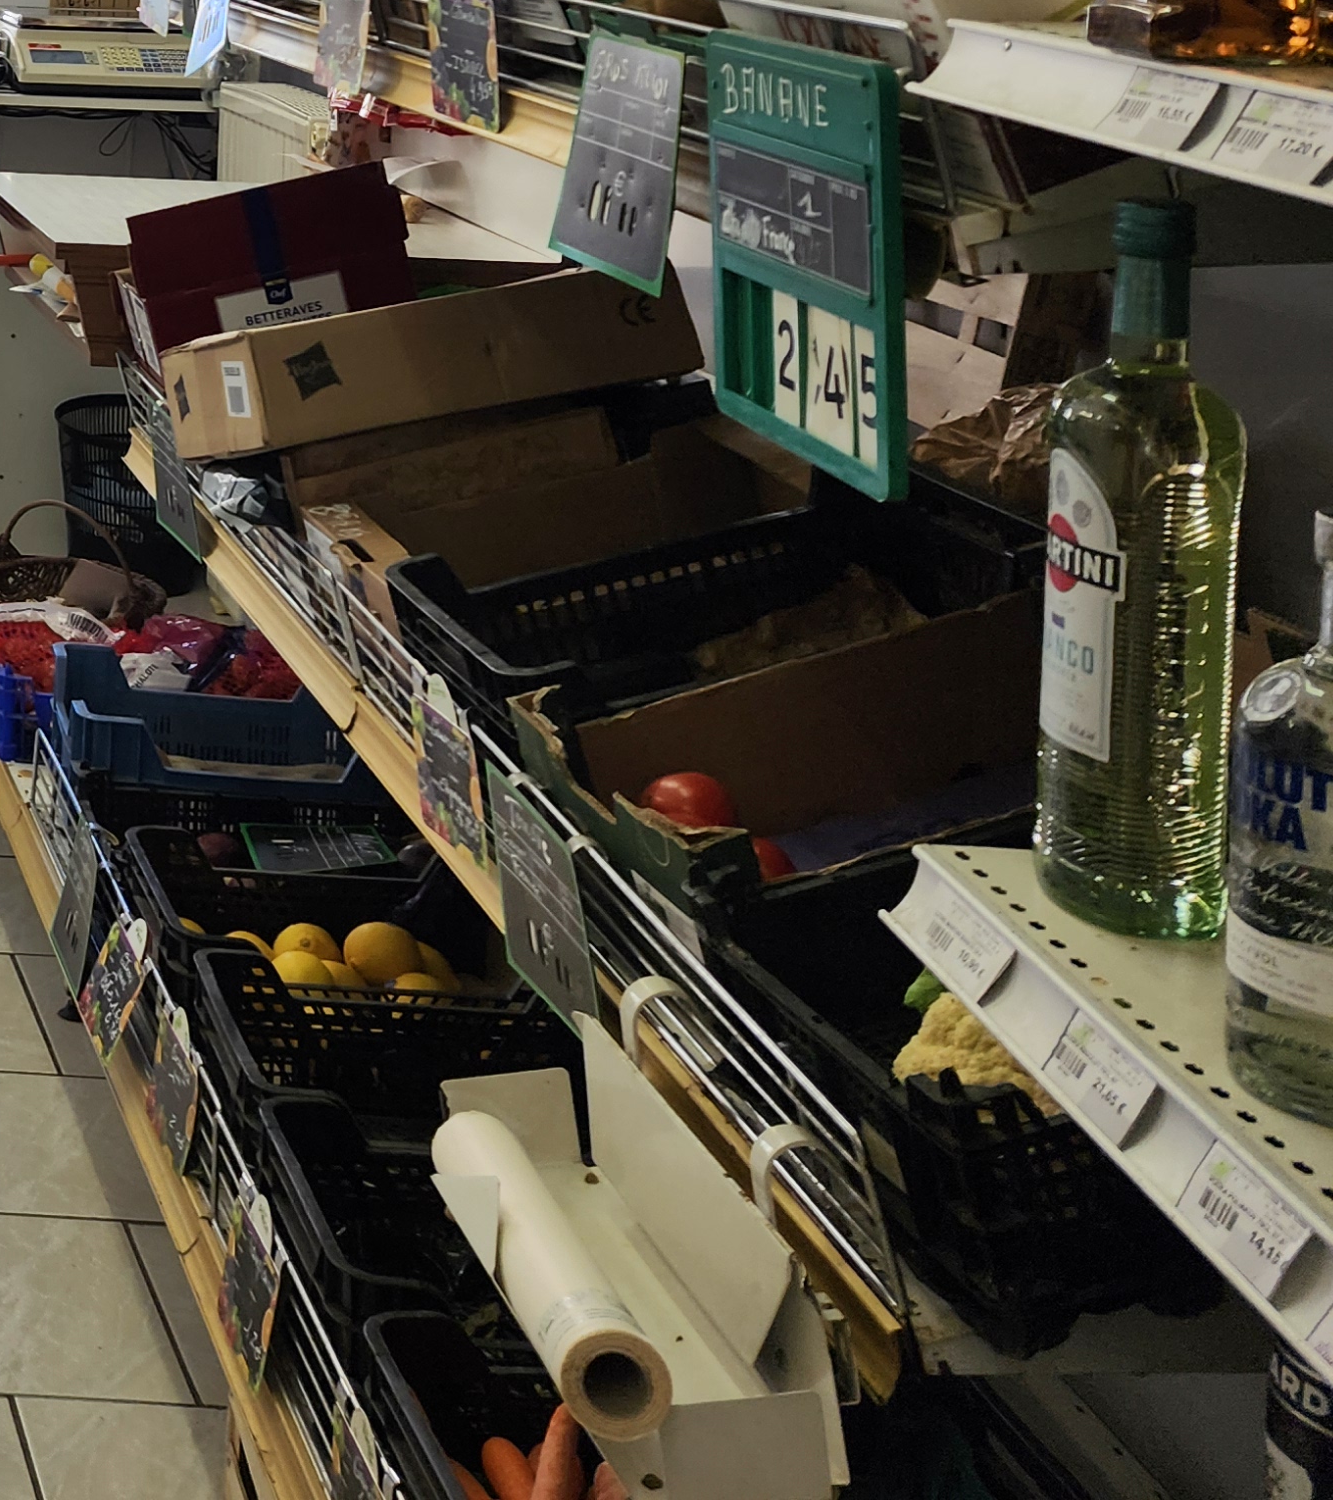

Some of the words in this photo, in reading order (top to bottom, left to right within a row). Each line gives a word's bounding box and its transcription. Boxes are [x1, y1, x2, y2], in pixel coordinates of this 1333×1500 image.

[719, 62, 830, 129] BANANE
[796, 190, 823, 219] 1
[244, 300, 324, 327] BETTERAVES
